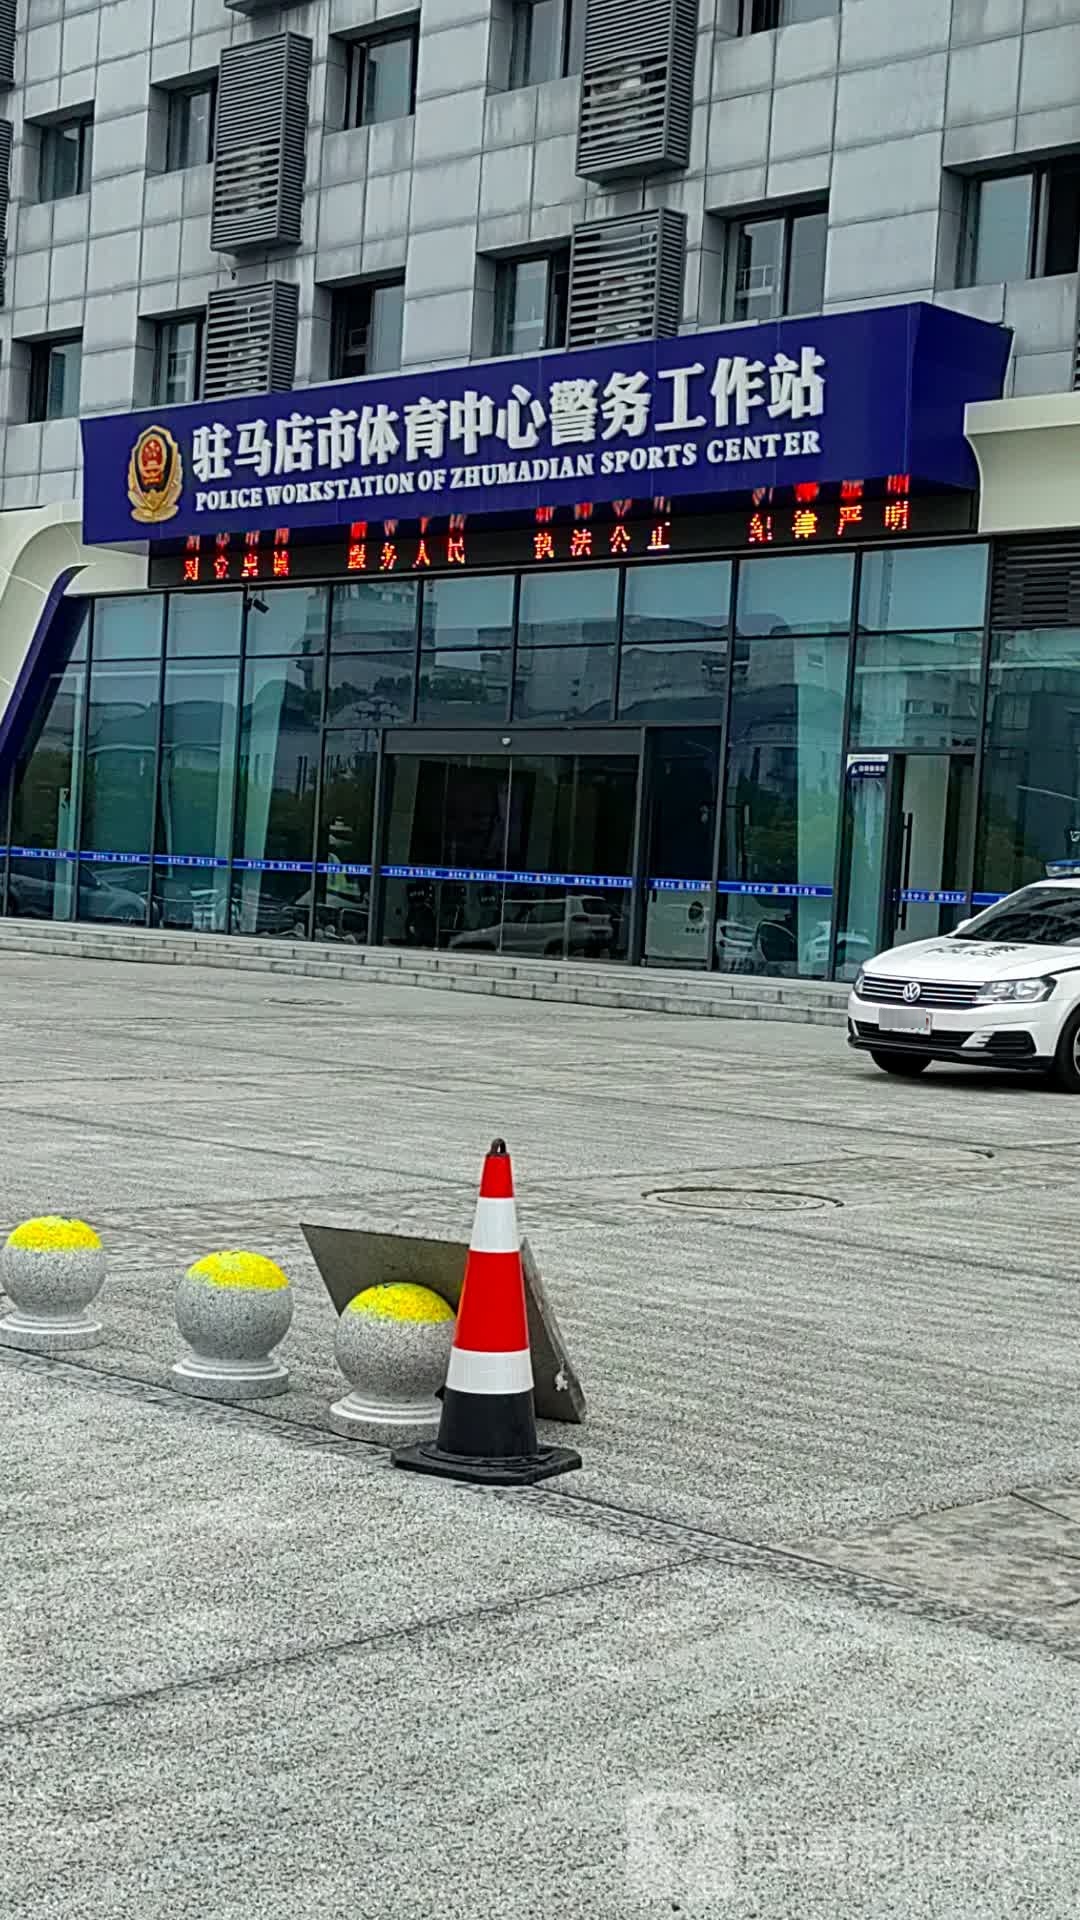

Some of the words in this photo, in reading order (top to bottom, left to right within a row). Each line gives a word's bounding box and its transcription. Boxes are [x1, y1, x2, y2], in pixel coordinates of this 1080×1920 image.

[191, 347, 826, 481] 驻马店市体育中心警务工作站
[195, 487, 263, 511] POLICE
[265, 471, 415, 506] WORKSTATION
[417, 469, 447, 491] OF
[450, 454, 595, 489] ZHUMADIAN
[600, 443, 697, 474] SPORTS
[706, 430, 822, 463] CENTER
[348, 538, 465, 570] 服务人民
[533, 521, 670, 559] 执法公正
[748, 500, 910, 542] 纪律严明
